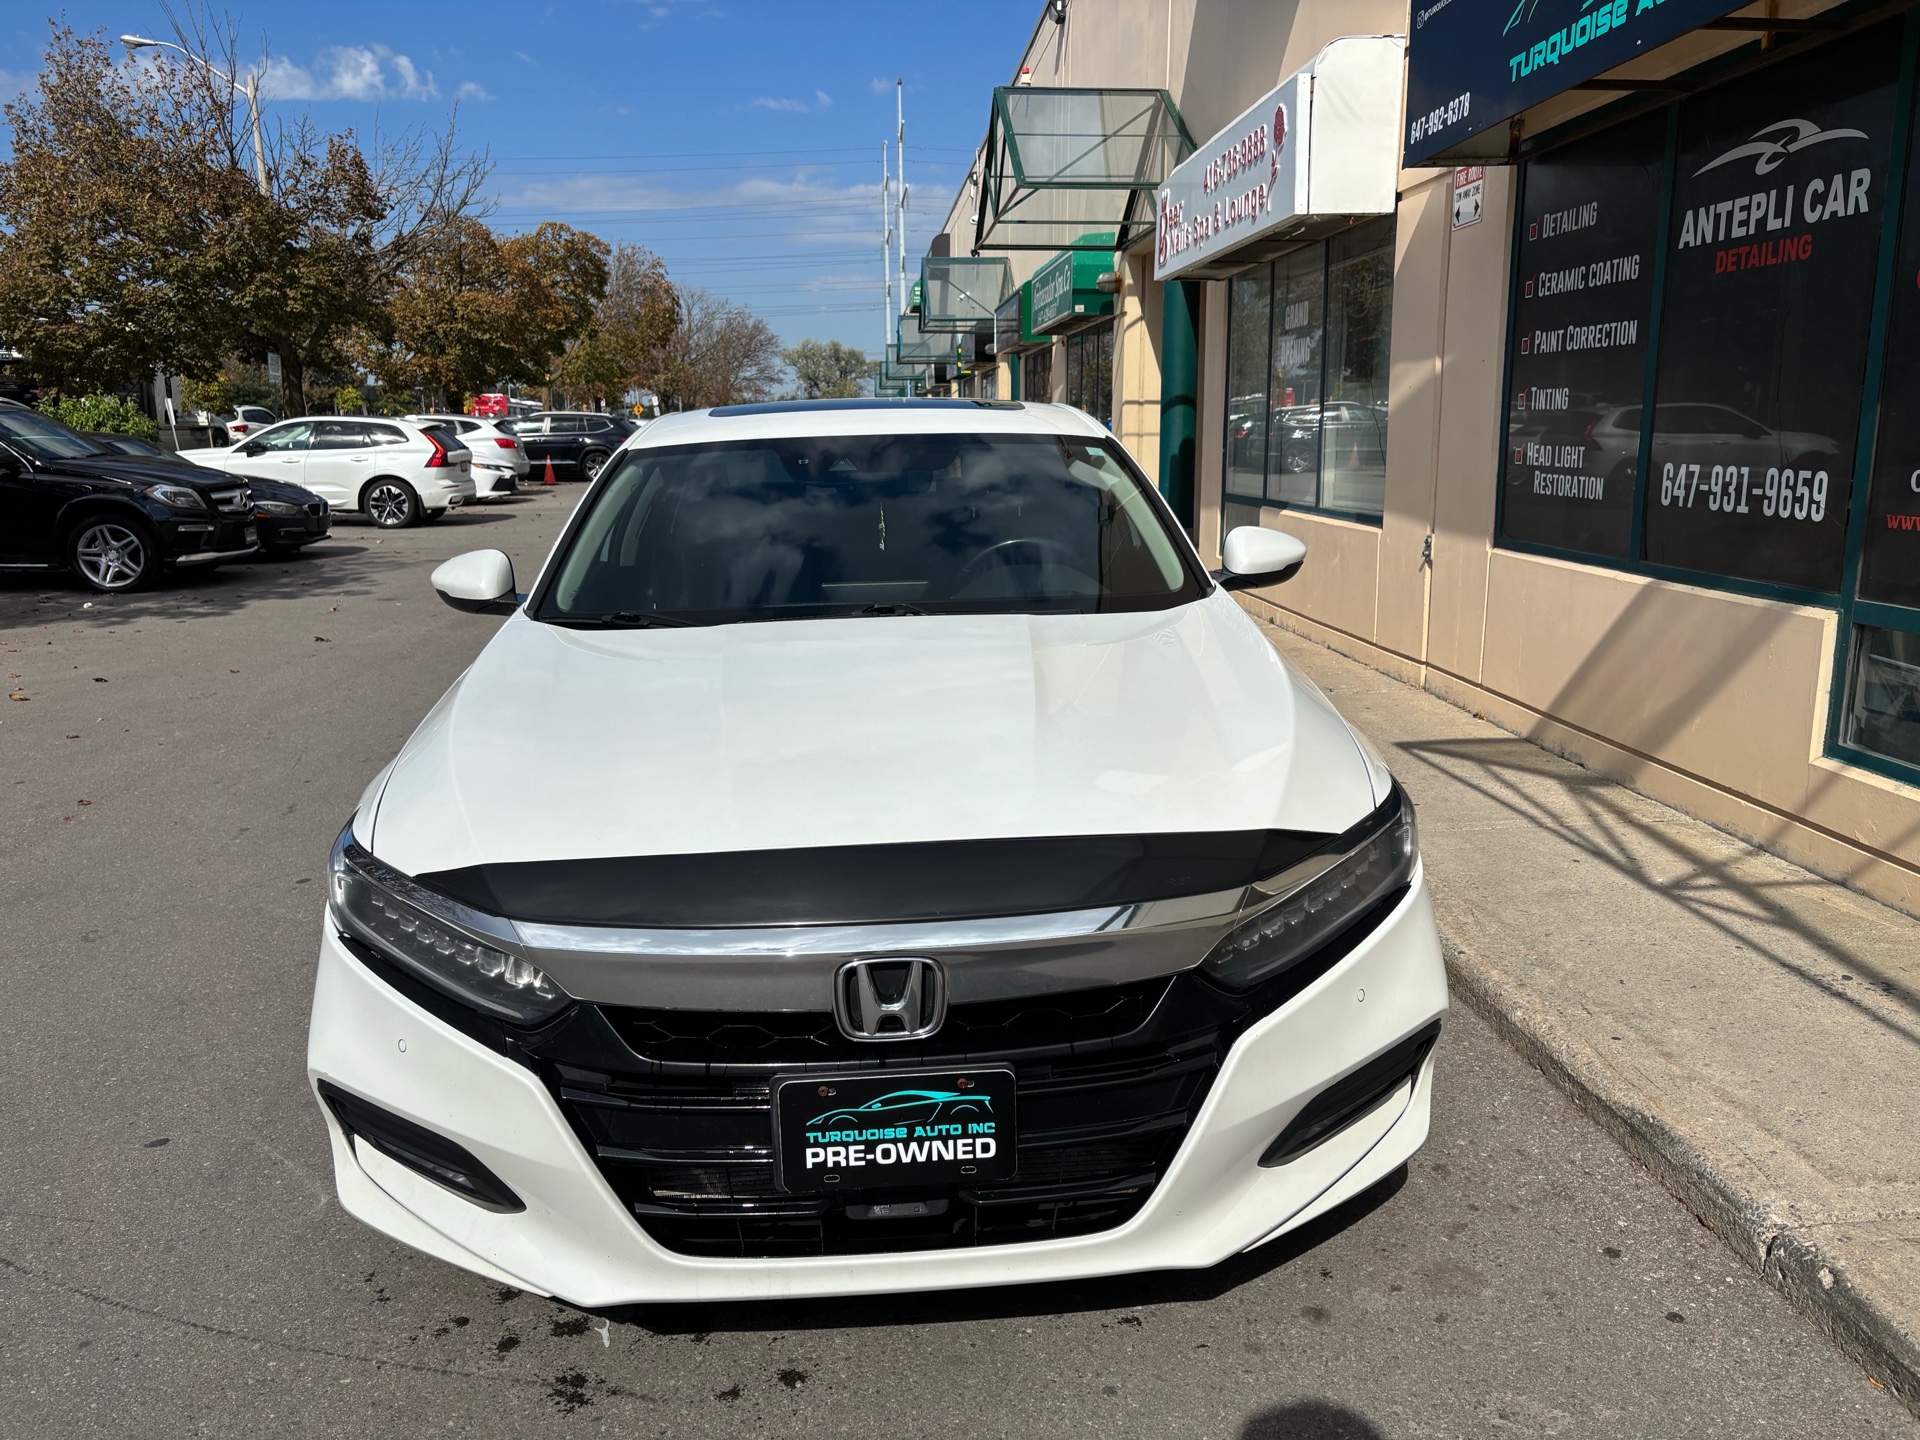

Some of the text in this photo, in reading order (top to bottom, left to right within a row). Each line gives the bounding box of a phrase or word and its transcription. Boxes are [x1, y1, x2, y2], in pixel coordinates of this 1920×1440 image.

[1410, 91, 1470, 145] 647-992-6378
[1457, 170, 1467, 188] FIRE
[1169, 183, 1267, 257] Nails Spa & Lounge
[1542, 201, 1598, 239] DETAILING
[1678, 167, 1871, 250] ANTEPLI CAR
[1714, 234, 1813, 275] DETAILING
[1538, 254, 1640, 297] CERAMIC COATING
[1285, 300, 1309, 331] GRAND
[1281, 336, 1311, 366] OPENING
[1534, 320, 1638, 354] PAINT CORRECTION
[1530, 387, 1569, 410] TINTING
[1526, 442, 1585, 469] HEAD LIGHT
[1533, 471, 1604, 501] RESTORATION
[1661, 462, 1829, 522] 647-931-9659
[806, 1122, 996, 1143] TURQUOISE AUTO INC
[806, 1137, 997, 1169] PRE-OWNED
